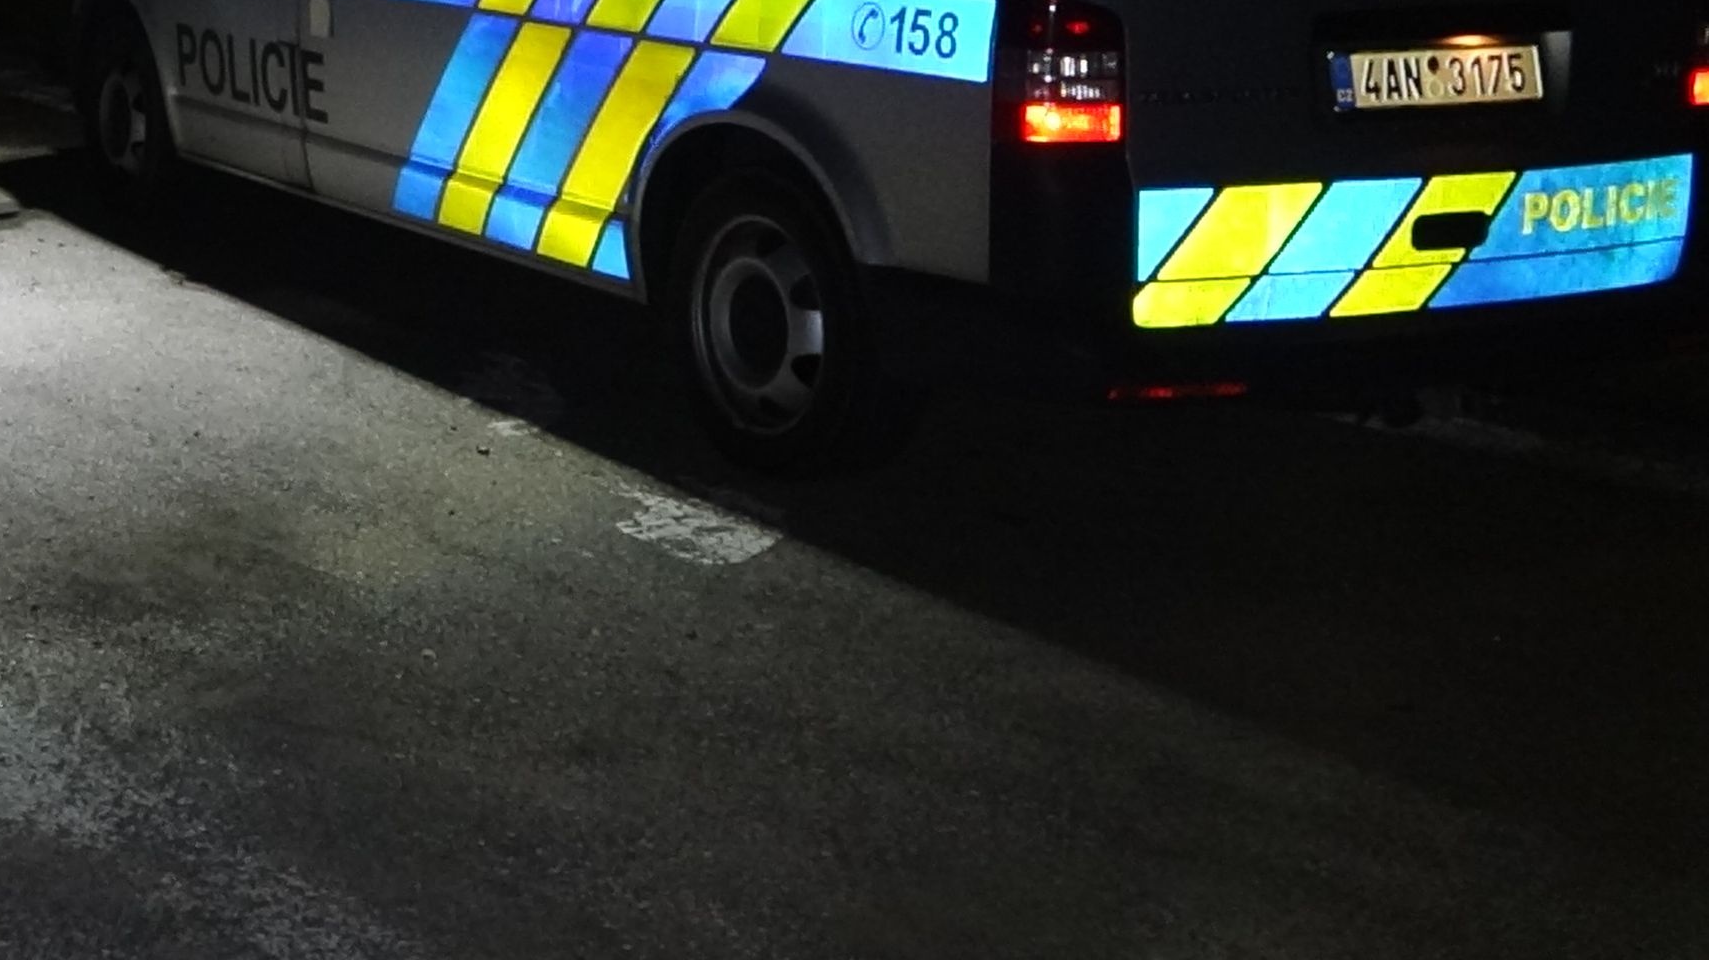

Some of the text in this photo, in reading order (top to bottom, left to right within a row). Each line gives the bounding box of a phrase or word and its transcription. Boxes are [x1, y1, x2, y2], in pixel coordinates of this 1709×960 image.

[890, 6, 959, 59] 158
[176, 16, 329, 124] POLICIE
[1363, 53, 1527, 101] 4AN 3175
[1522, 178, 1679, 235] POLICIE
